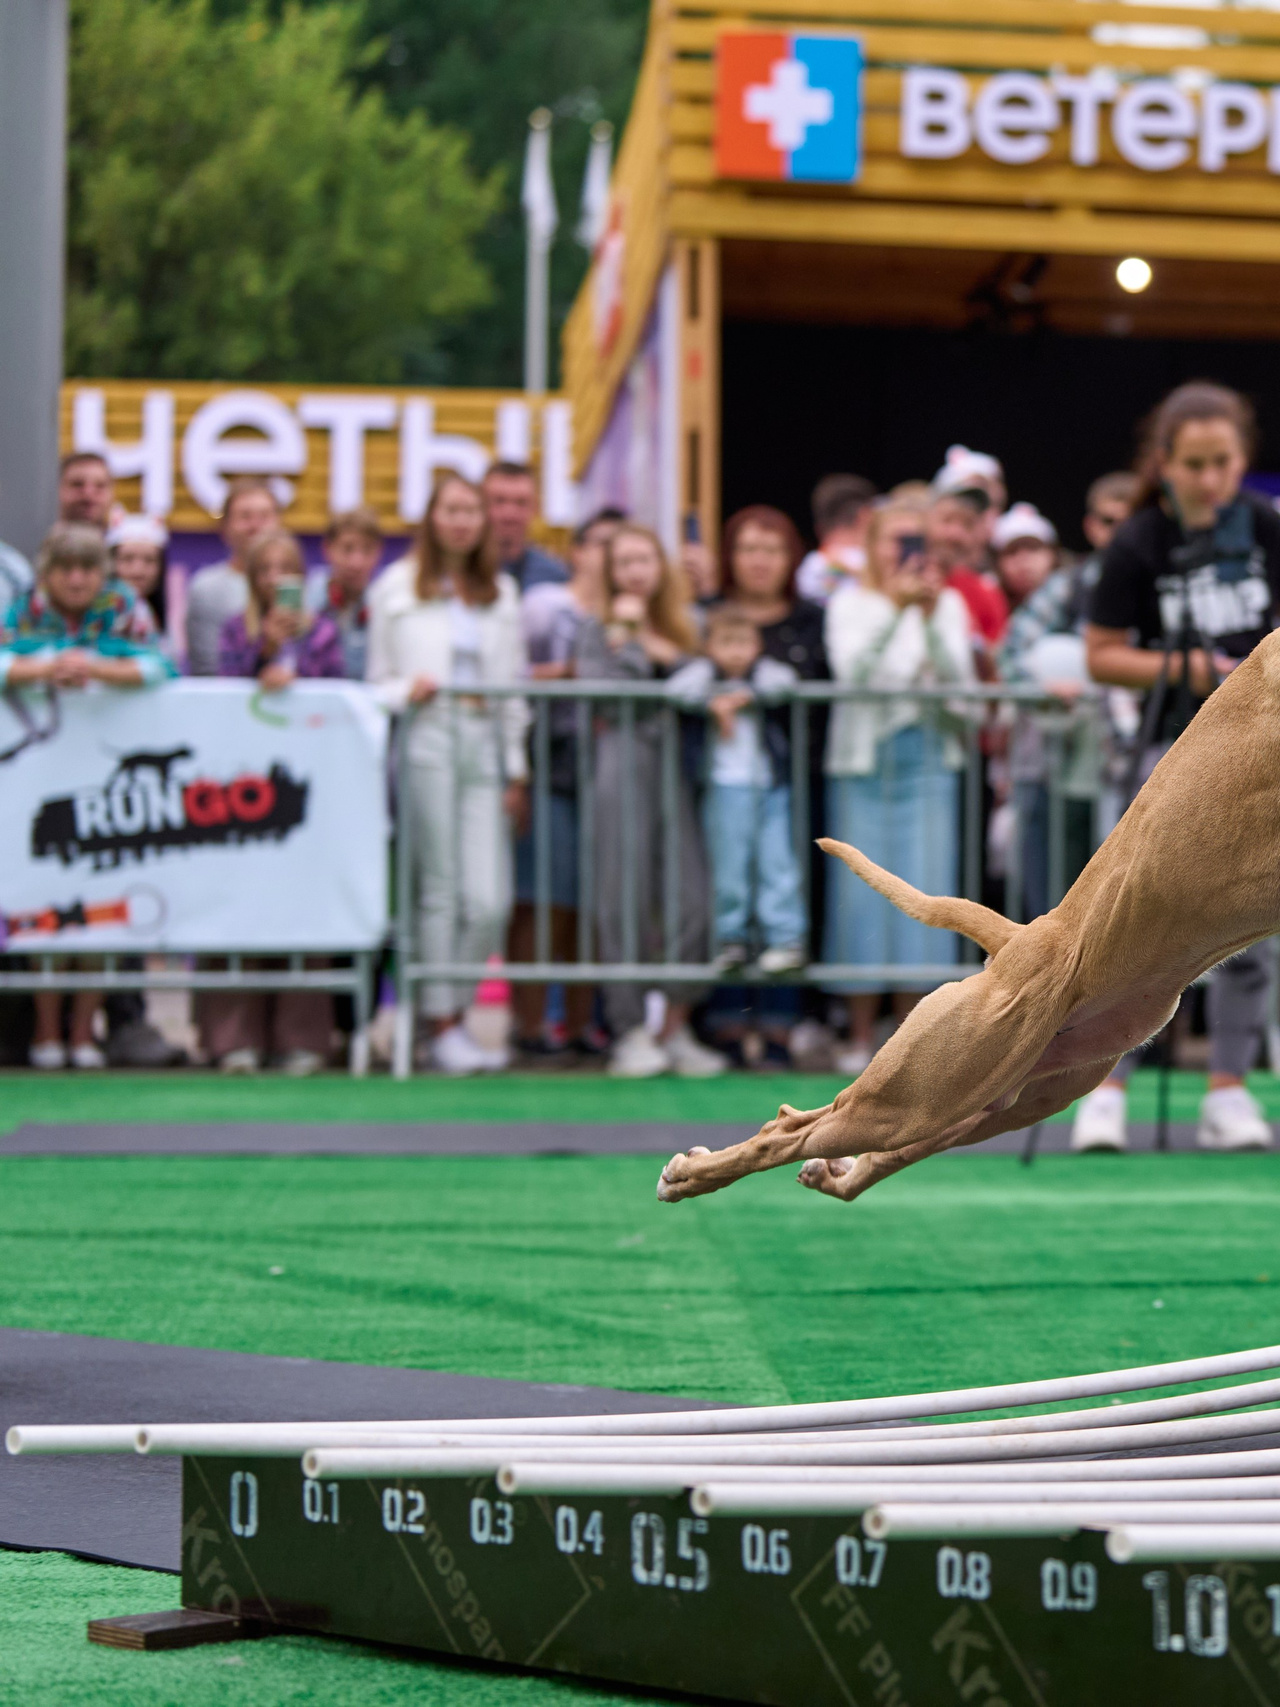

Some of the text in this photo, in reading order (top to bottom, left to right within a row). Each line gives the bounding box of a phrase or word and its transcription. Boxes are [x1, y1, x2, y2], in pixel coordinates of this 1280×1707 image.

[230, 1471, 258, 1537] 0
[303, 1479, 339, 1524] 0.1
[382, 1487, 426, 1534] 0.2
[470, 1497, 514, 1545] 0.3
[555, 1505, 604, 1555] 0.4
[631, 1512, 709, 1591] 0.5
[741, 1523, 791, 1575] 0.6
[835, 1534, 886, 1587] 0.7
[937, 1546, 991, 1600] 0.8
[1041, 1558, 1096, 1610] 0.9
[1143, 1571, 1229, 1658] 1.0
